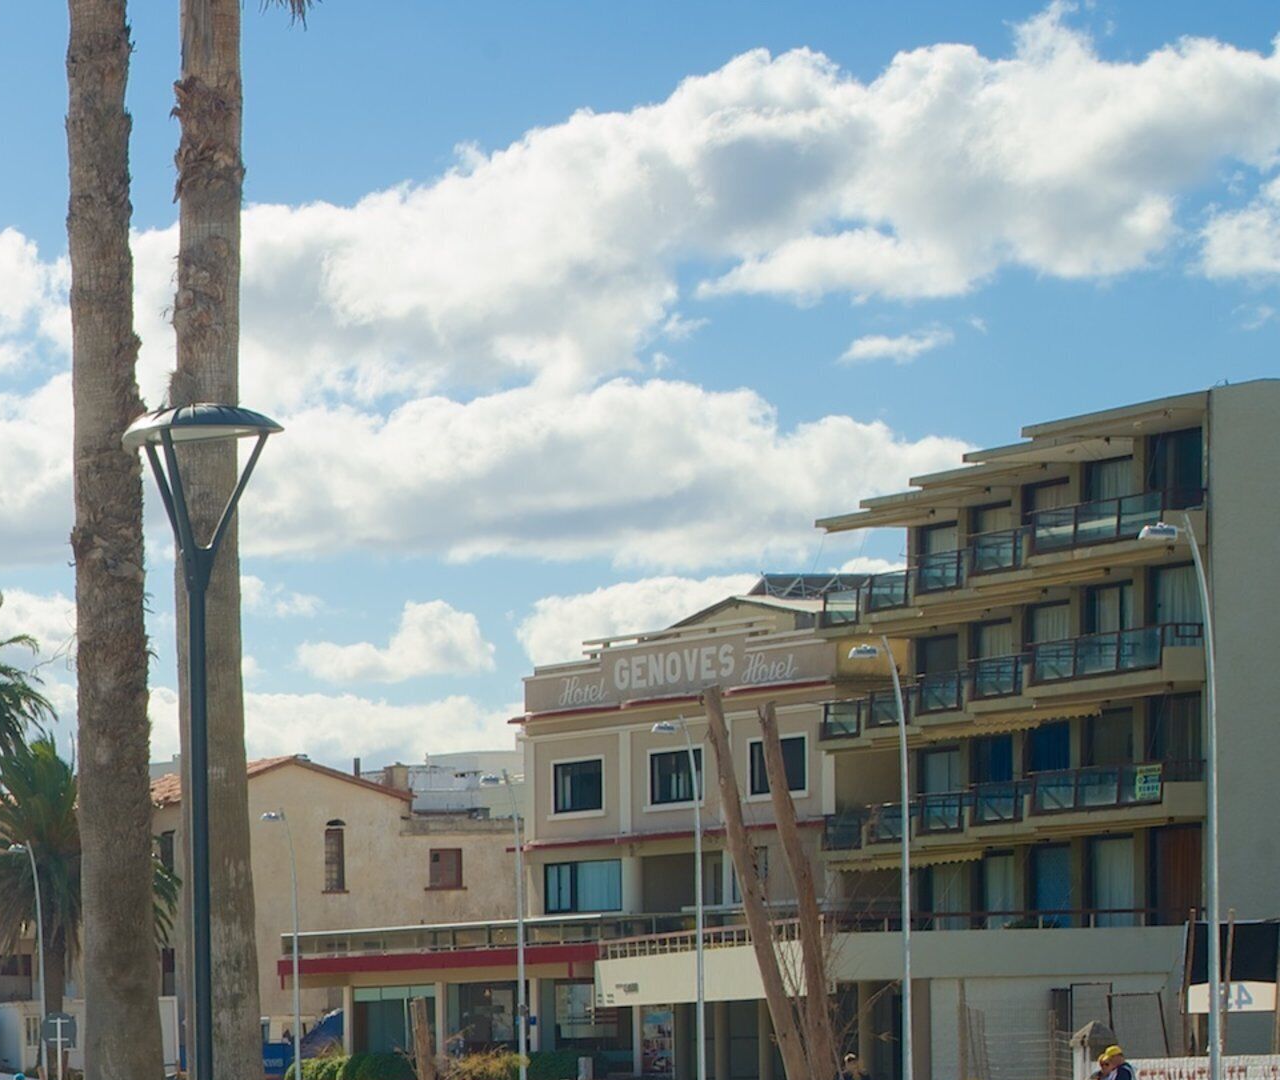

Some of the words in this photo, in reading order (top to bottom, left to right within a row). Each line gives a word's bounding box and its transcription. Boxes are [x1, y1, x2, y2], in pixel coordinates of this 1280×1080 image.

[559, 675, 608, 706] Hotel
[614, 643, 735, 690] GENOVES
[741, 652, 799, 684] Hotel
